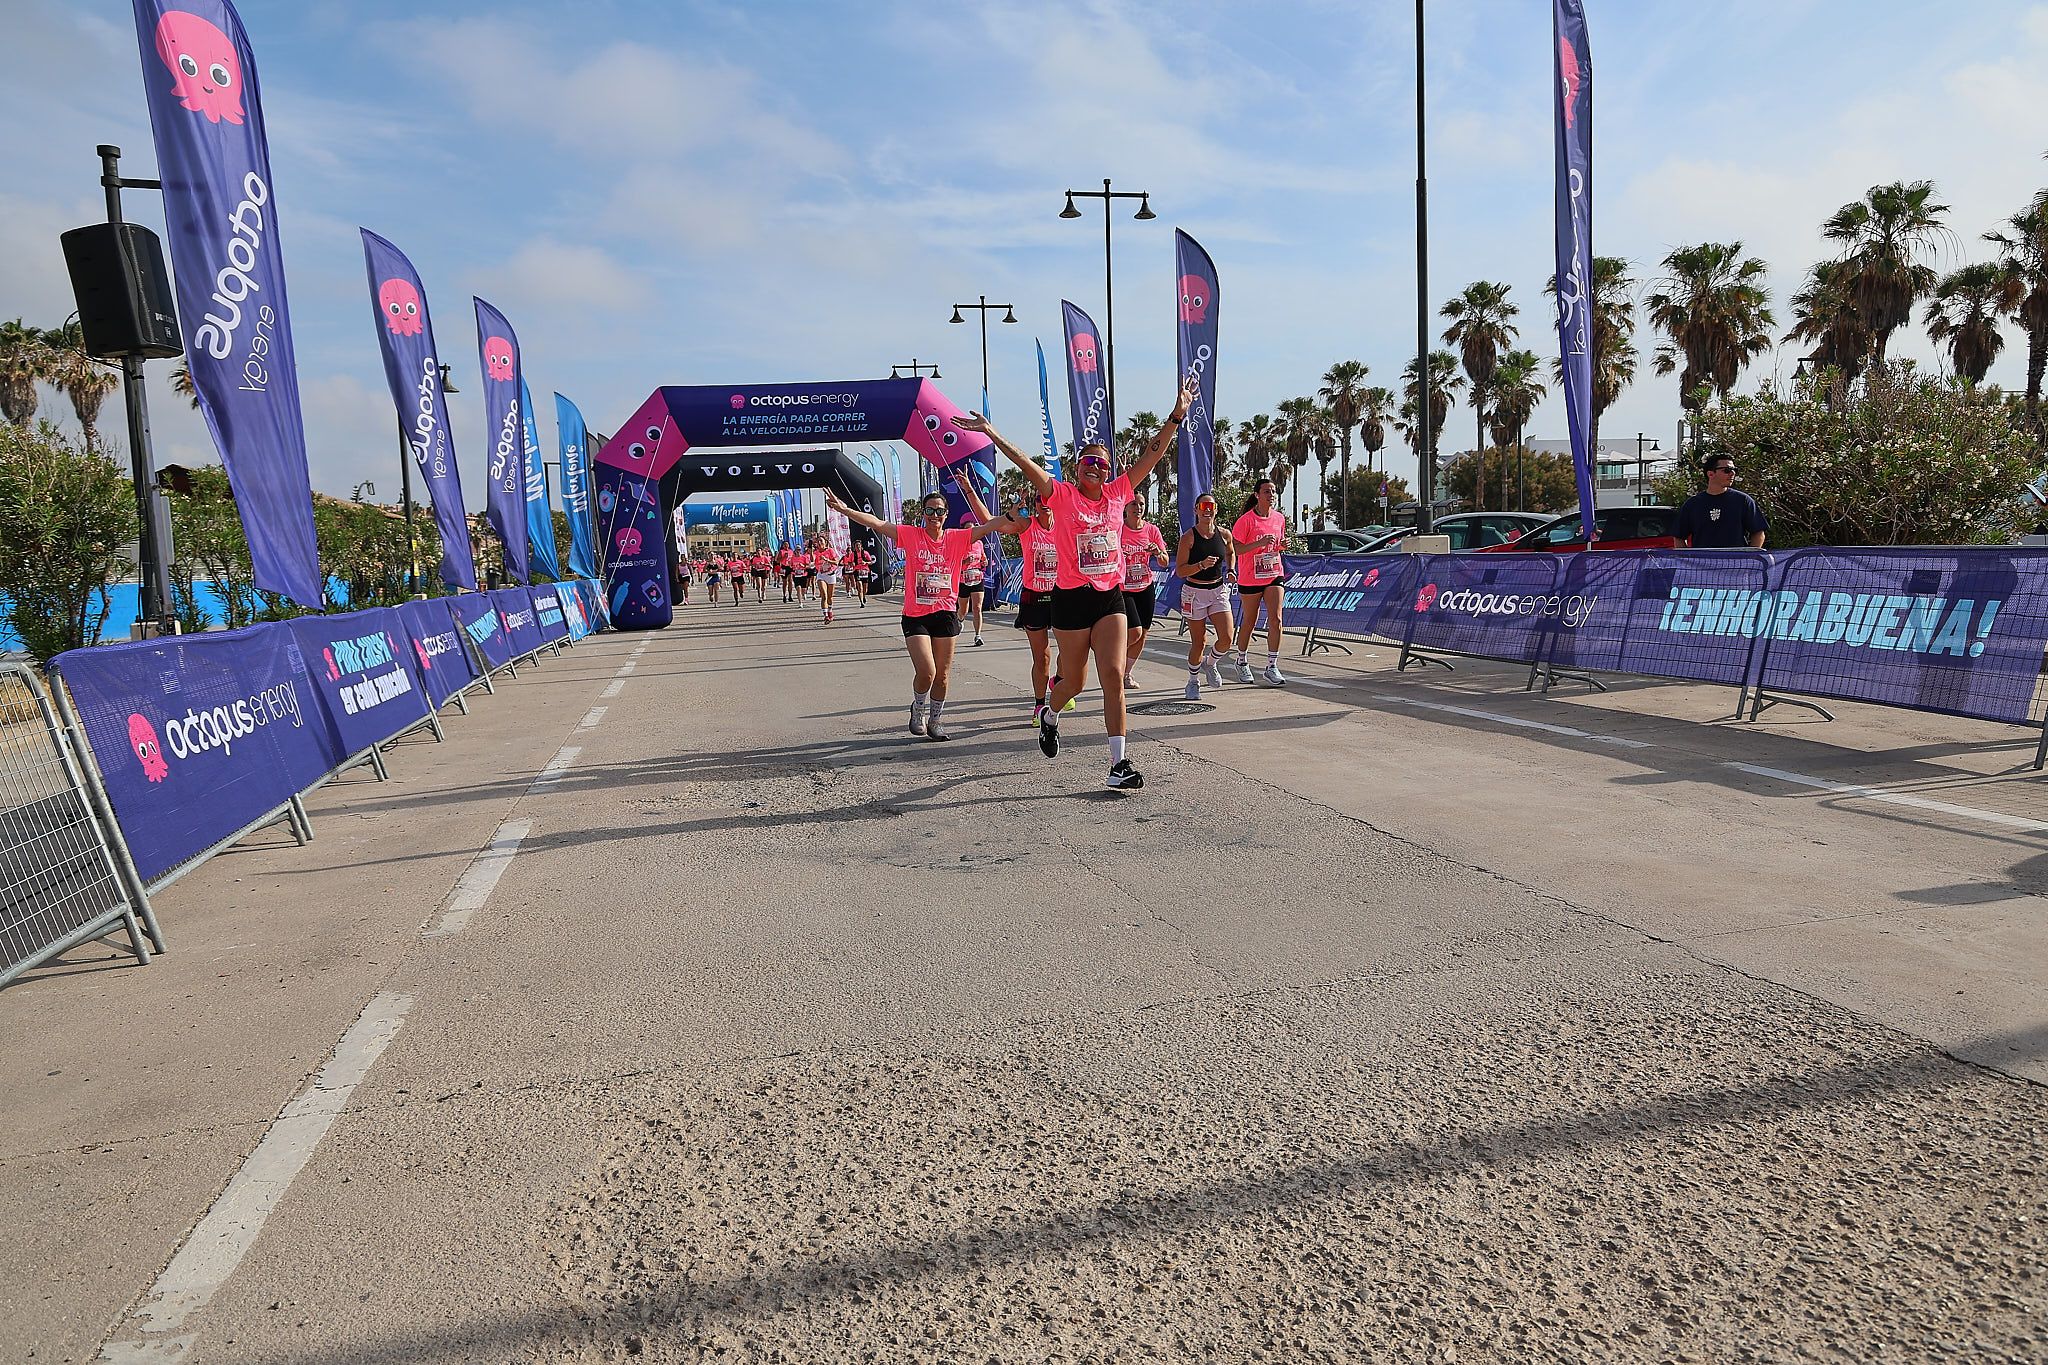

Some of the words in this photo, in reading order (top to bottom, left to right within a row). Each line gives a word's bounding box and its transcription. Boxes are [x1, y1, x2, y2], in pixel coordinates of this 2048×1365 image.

[750, 394, 810, 409] octopus
[810, 393, 860, 407] energy
[723, 416, 737, 425] LA
[740, 413, 787, 425] ENERGÍA
[790, 413, 819, 423] PARA
[822, 412, 866, 422] CORRER
[722, 428, 731, 436] A
[733, 427, 747, 436] LA
[750, 425, 812, 435] VELOCIDAD
[814, 425, 828, 433] DE
[831, 424, 845, 433] LA
[847, 423, 868, 432] LUZ
[700, 462, 816, 478] VOLVO
[1319, 590, 1341, 609] LA
[1334, 591, 1365, 612] LUZ
[1439, 588, 1519, 617] octopus
[1518, 594, 1598, 628] energy
[1658, 586, 2002, 658] ¡ENHORABUENA!
[165, 699, 254, 759] octopus
[249, 680, 304, 728] energy
